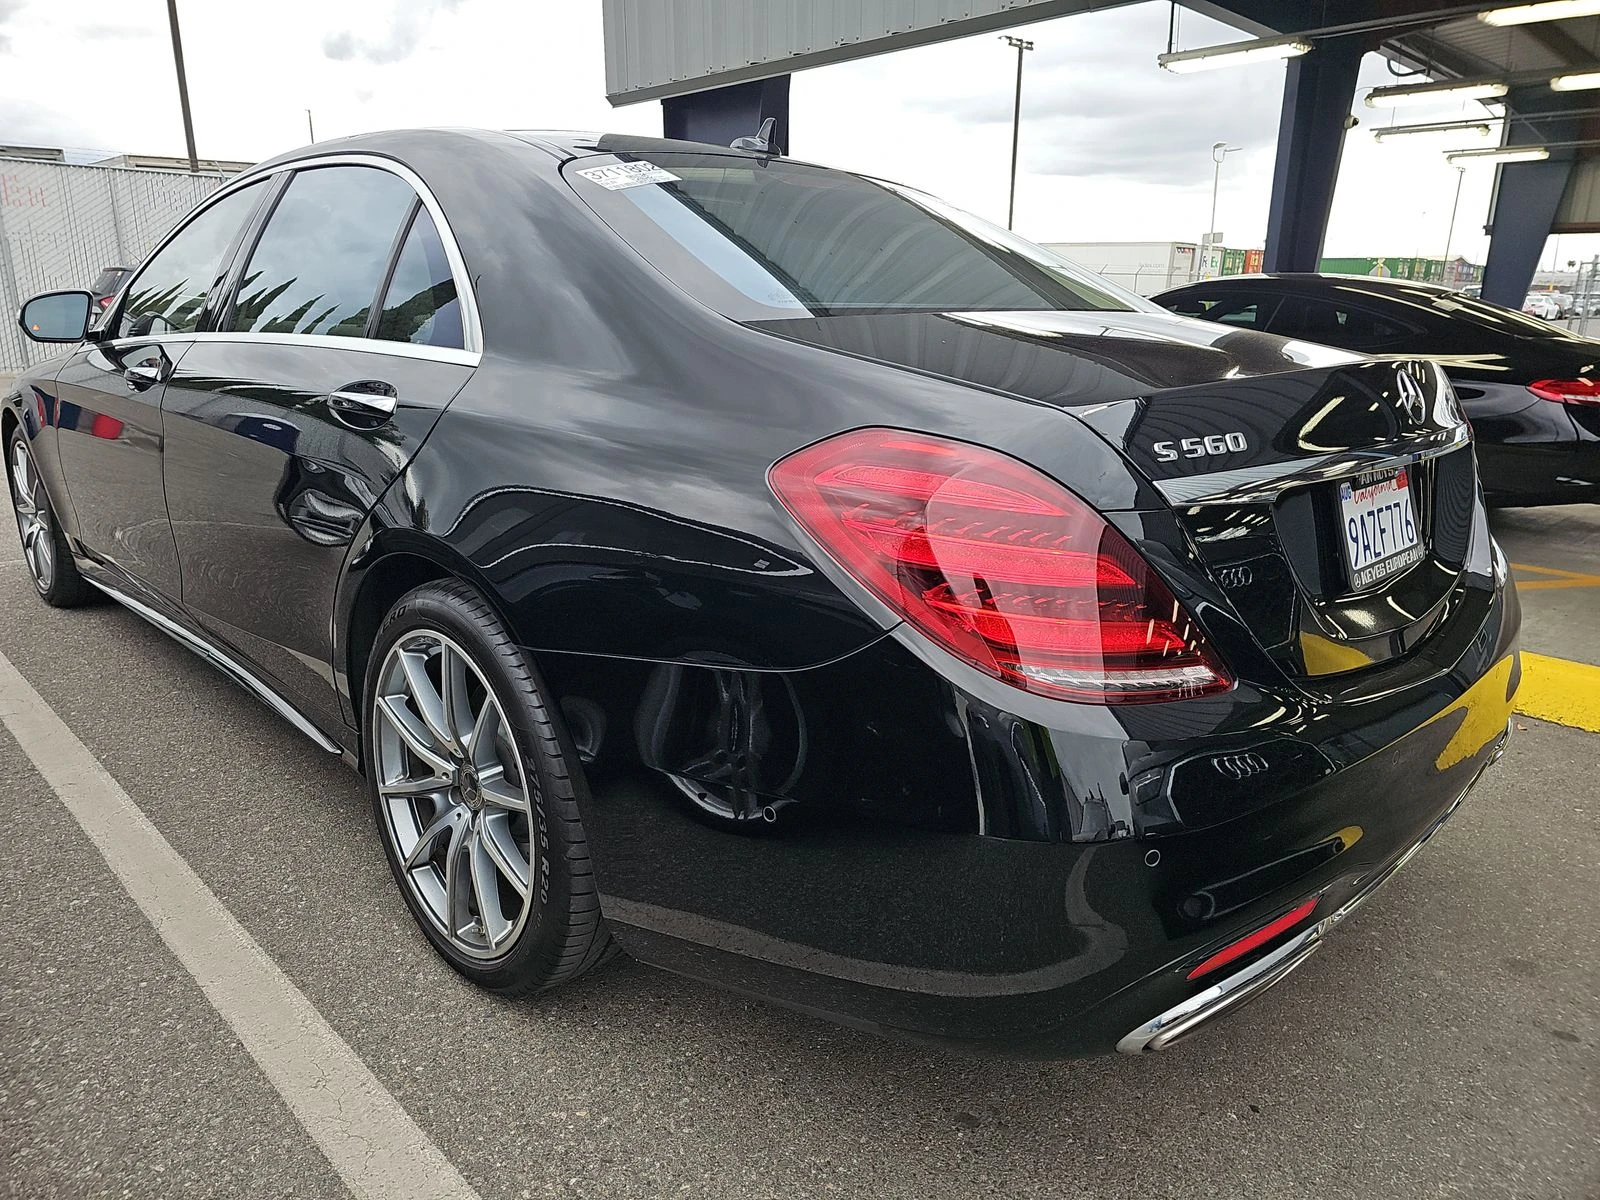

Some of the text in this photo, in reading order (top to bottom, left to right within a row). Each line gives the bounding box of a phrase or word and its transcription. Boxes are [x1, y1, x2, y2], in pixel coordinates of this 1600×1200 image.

[584, 162, 661, 180] 3711802
[1202, 255, 1219, 268] FeEx
[1153, 432, 1248, 462] S 560
[1348, 498, 1415, 568] 9AZF776
[1361, 548, 1419, 585] KEYES EUROPEAN
[525, 753, 550, 905] 275/35 R20
